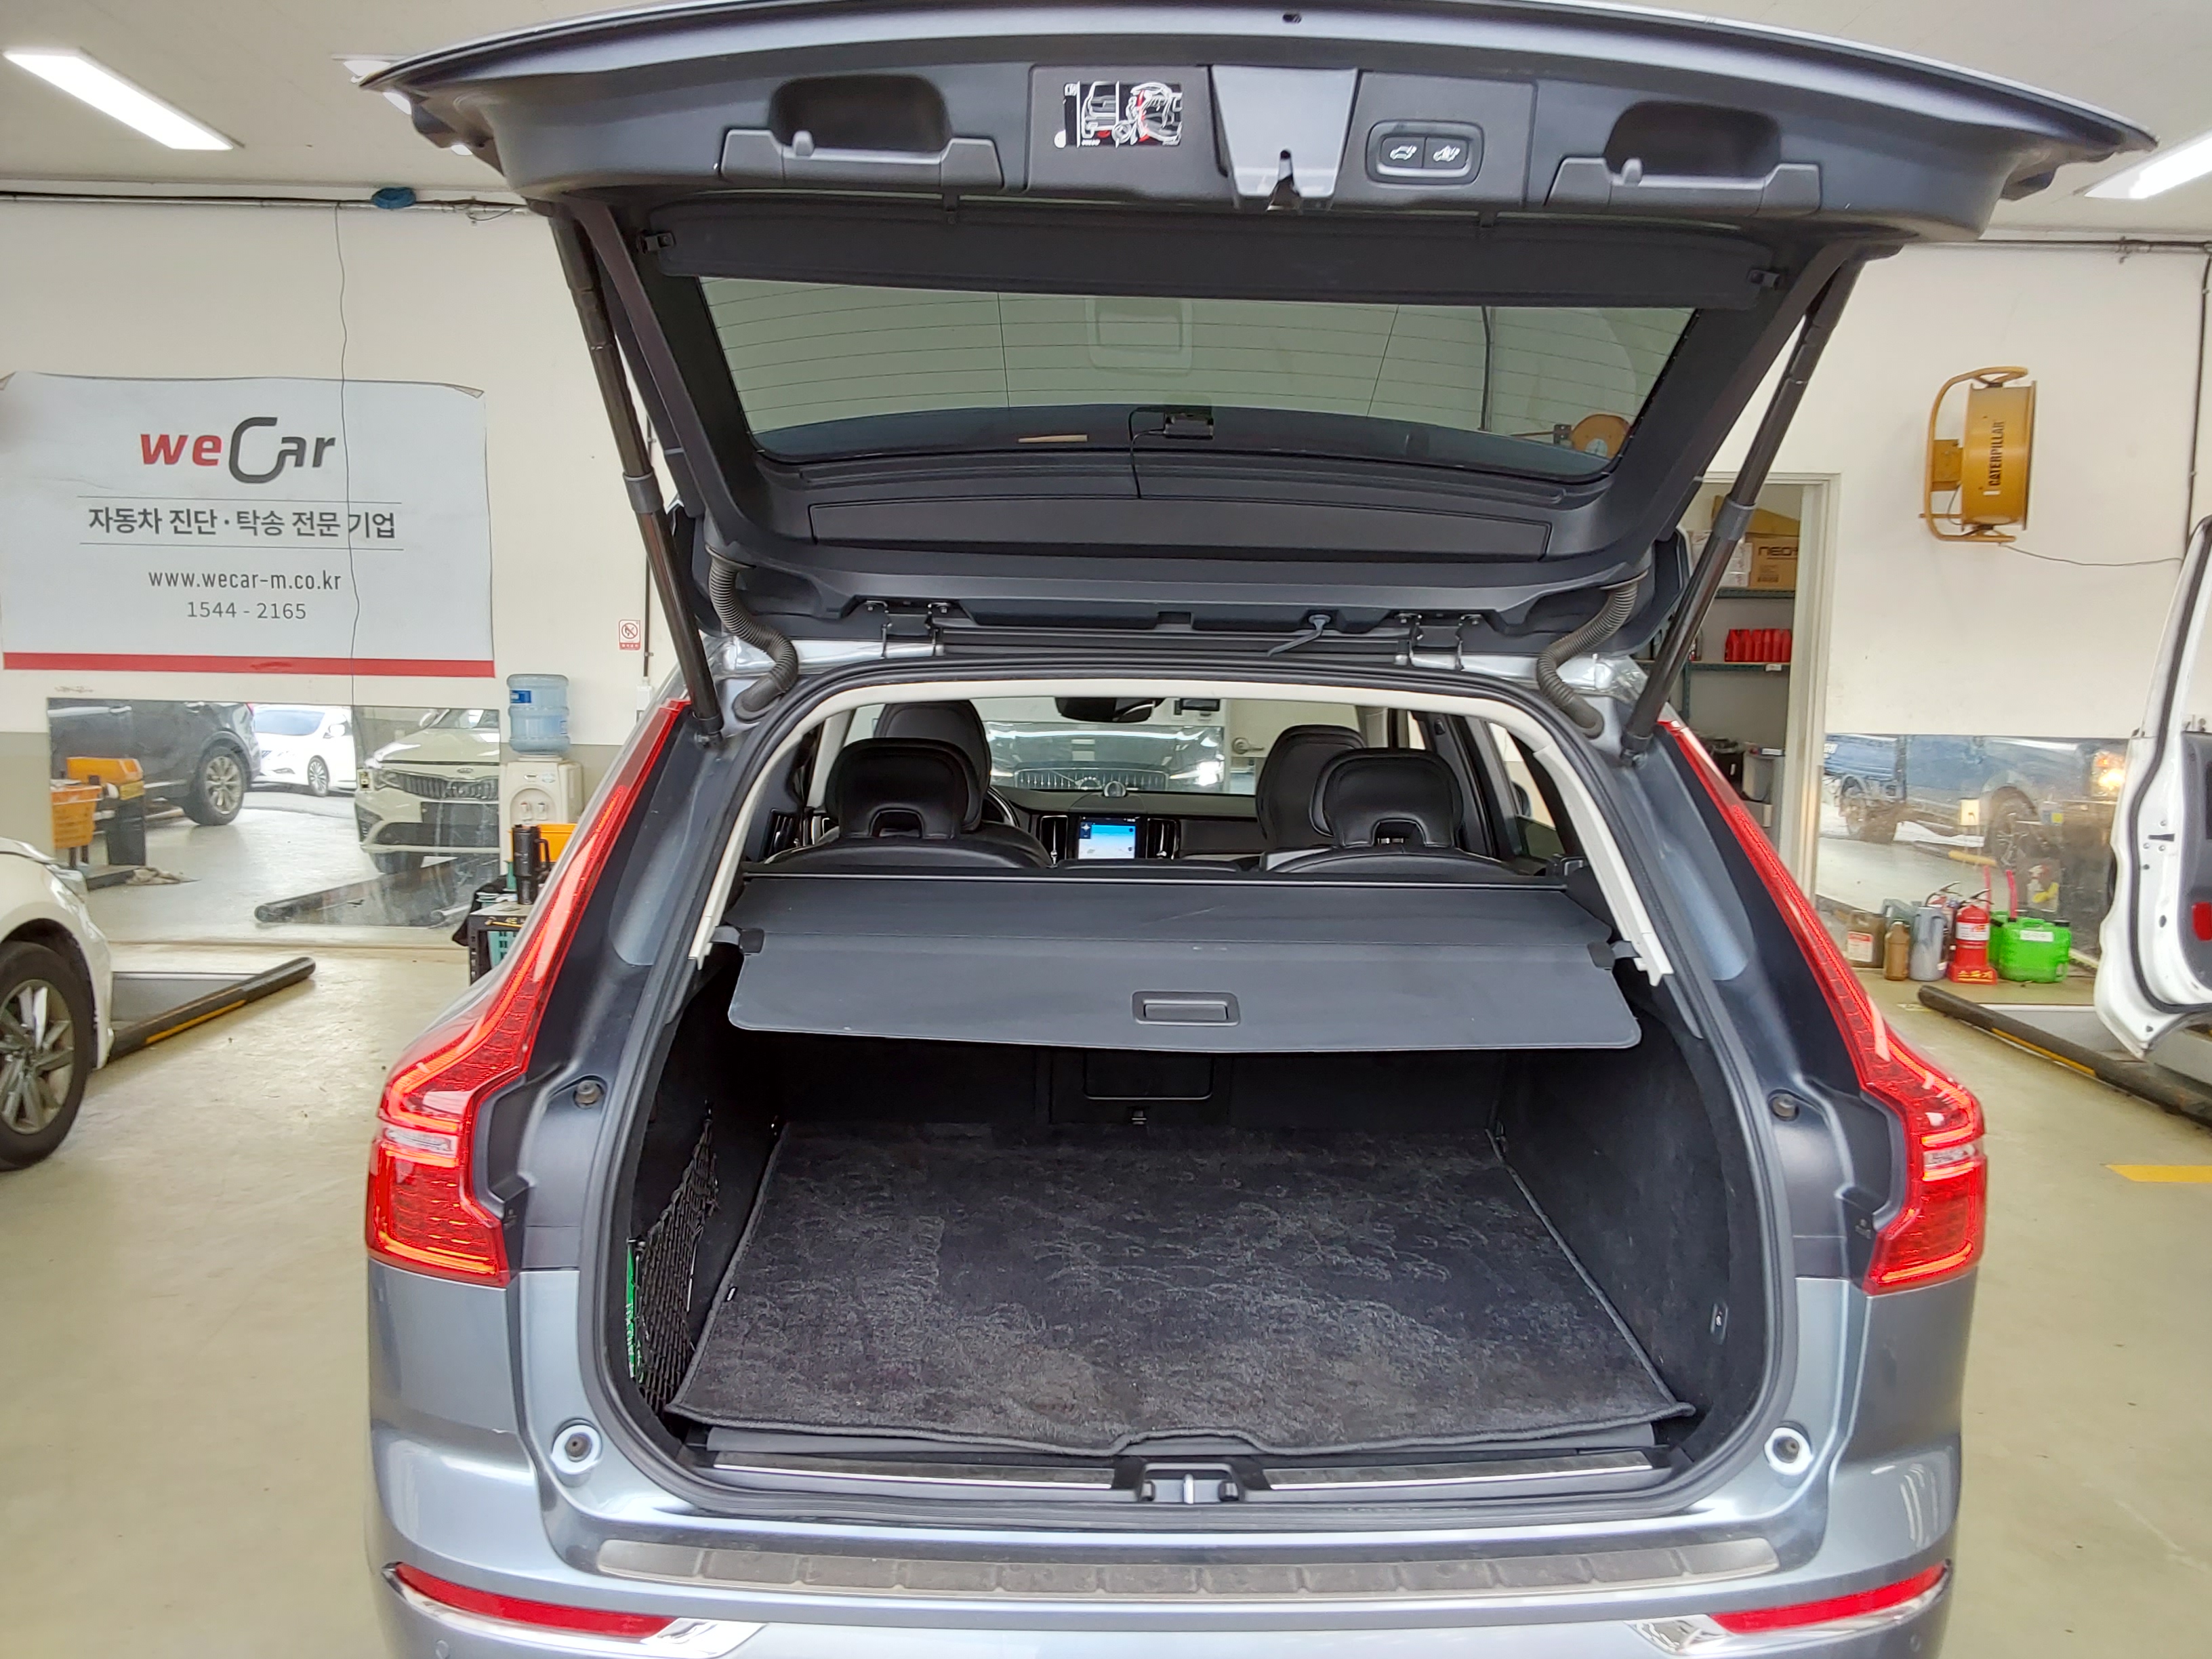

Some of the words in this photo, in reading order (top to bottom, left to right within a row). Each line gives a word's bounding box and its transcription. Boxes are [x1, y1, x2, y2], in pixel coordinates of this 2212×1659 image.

[140, 416, 336, 484] weCar
[1988, 421, 2004, 486] CATERPILLAR
[88, 506, 163, 535] 자동차
[291, 511, 341, 537] 전문
[348, 512, 395, 539] 기업
[148, 570, 342, 590] www.wecar-m.co.kr
